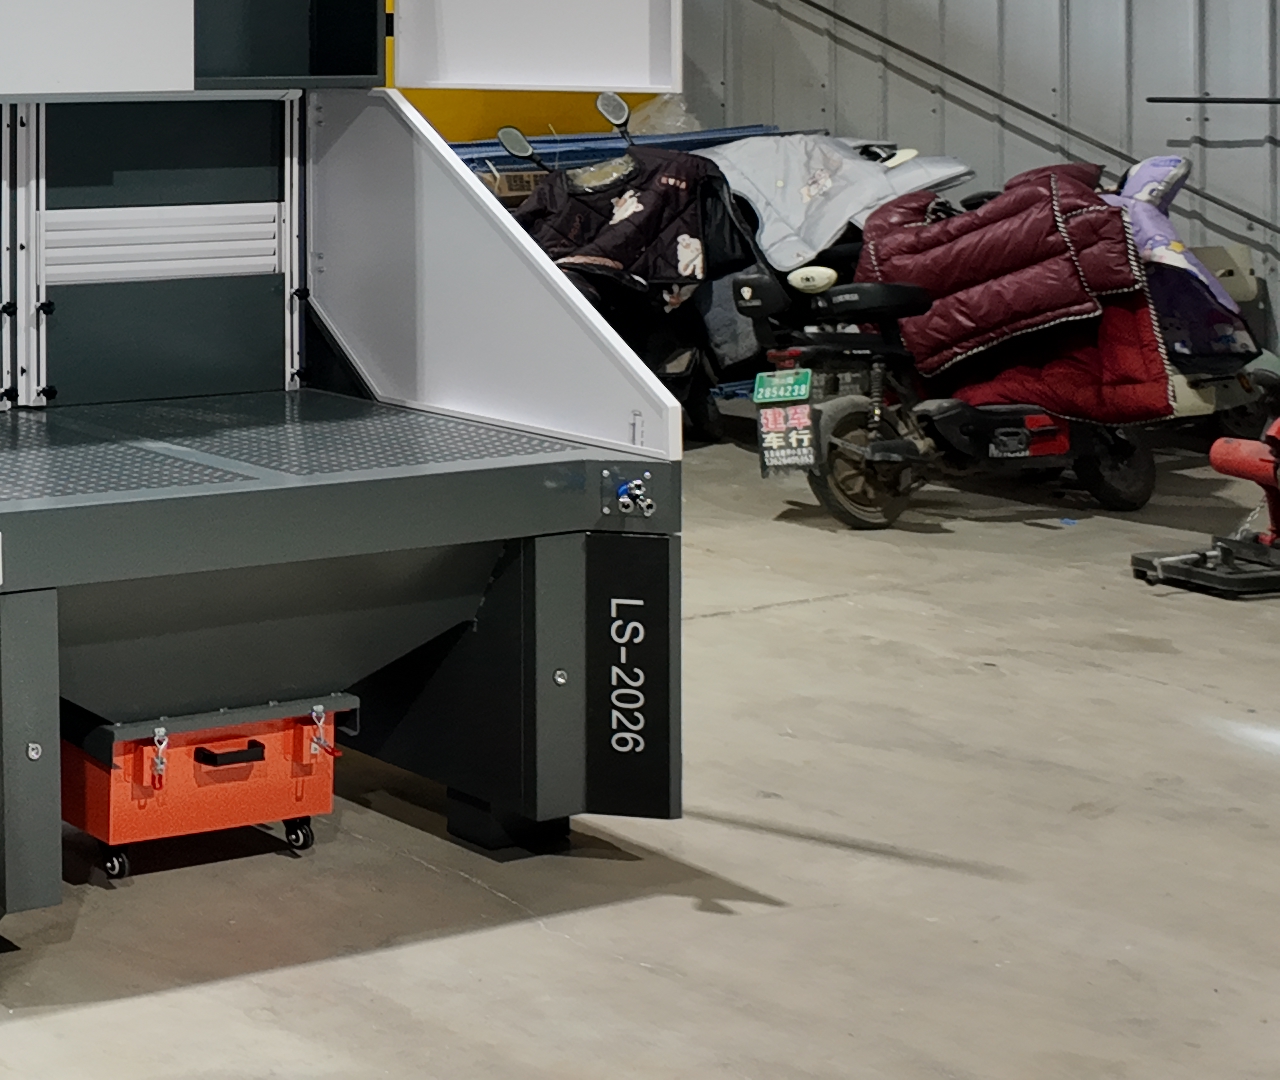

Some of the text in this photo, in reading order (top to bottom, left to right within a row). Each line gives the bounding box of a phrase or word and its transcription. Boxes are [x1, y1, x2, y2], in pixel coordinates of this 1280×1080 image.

[757, 383, 807, 399] 2854238
[761, 429, 813, 450] 车行
[609, 597, 646, 754] LS-2026
